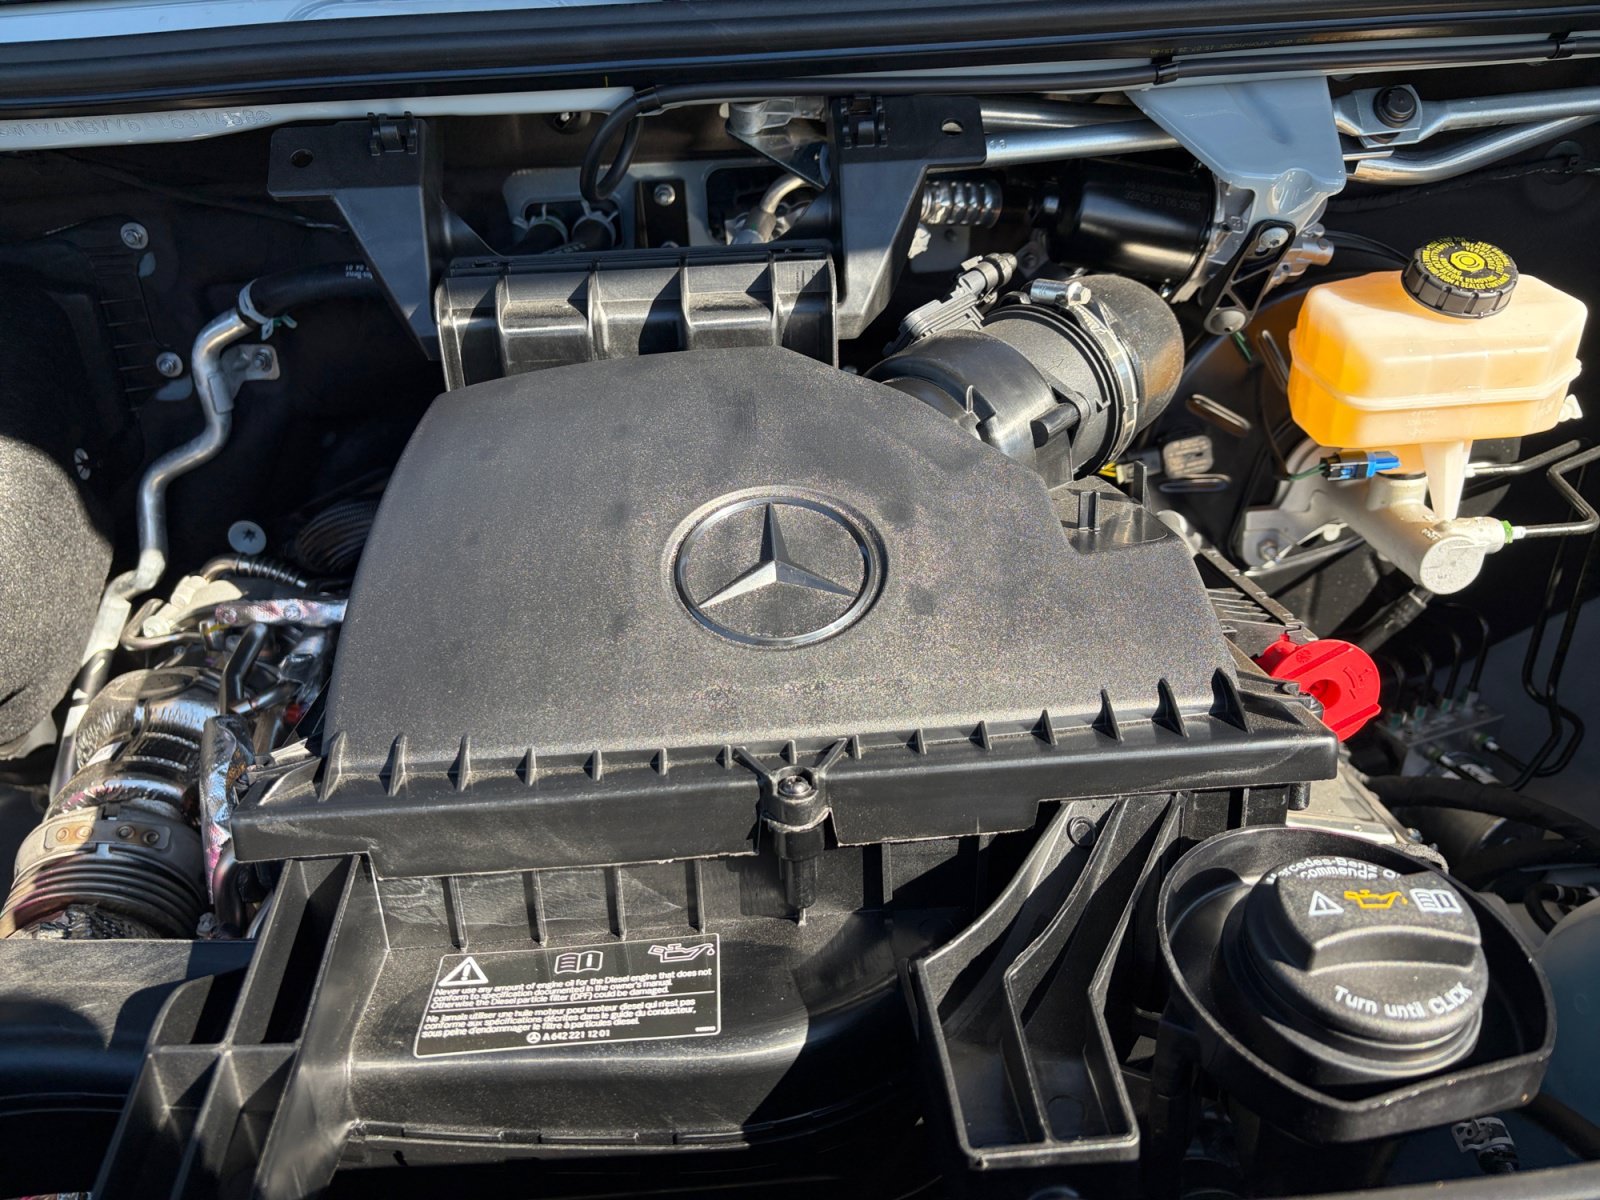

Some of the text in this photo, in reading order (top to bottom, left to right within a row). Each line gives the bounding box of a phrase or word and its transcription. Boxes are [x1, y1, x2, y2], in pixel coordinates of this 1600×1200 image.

[433, 994, 468, 1003] conform
[481, 990, 532, 1000] specification
[534, 985, 585, 996] documented
[610, 982, 641, 990] owner's
[643, 979, 672, 987] manual.
[494, 984, 524, 992] amount
[536, 980, 562, 990] engine
[576, 978, 588, 986] for
[605, 976, 629, 984] Diesel
[630, 973, 657, 982] engine
[659, 970, 675, 978] that
[677, 970, 696, 978] does
[431, 1001, 473, 1009] Otherwise
[491, 998, 515, 1006] Diesel
[517, 996, 547, 1004] particle
[570, 992, 592, 1001] (DPF)
[594, 991, 615, 999] could
[617, 989, 627, 997] be
[629, 987, 669, 996] damaged.
[1334, 981, 1473, 1018] Turn until CLICK
[424, 1021, 465, 1030] conforme
[484, 1015, 542, 1027] spécifications
[544, 1014, 579, 1022] décrites
[580, 1012, 599, 1021] dans
[610, 1010, 633, 1020] guide
[635, 1009, 646, 1017] du
[647, 1006, 696, 1016] conducteur,
[426, 1015, 438, 1023] Ne
[440, 1013, 467, 1023] jamais
[470, 1012, 495, 1020] utiliser
[515, 1009, 533, 1017] huile
[535, 1008, 564, 1016] moteur
[567, 1007, 585, 1015] pour
[587, 1004, 618, 1012] moteur
[620, 1001, 644, 1010] diesel
[646, 1001, 658, 1009] qui
[659, 999, 678, 1007] n'est
[680, 999, 695, 1007] pas
[422, 1030, 442, 1038] sous
[443, 1028, 467, 1038] peine
[468, 1024, 531, 1034] d'endommager
[542, 1022, 562, 1030] filtre
[570, 1018, 611, 1030] particules
[552, 1032, 567, 1040] 642
[569, 1030, 584, 1038] 221
[588, 1030, 597, 1038] 12
[599, 1029, 610, 1037] 01
